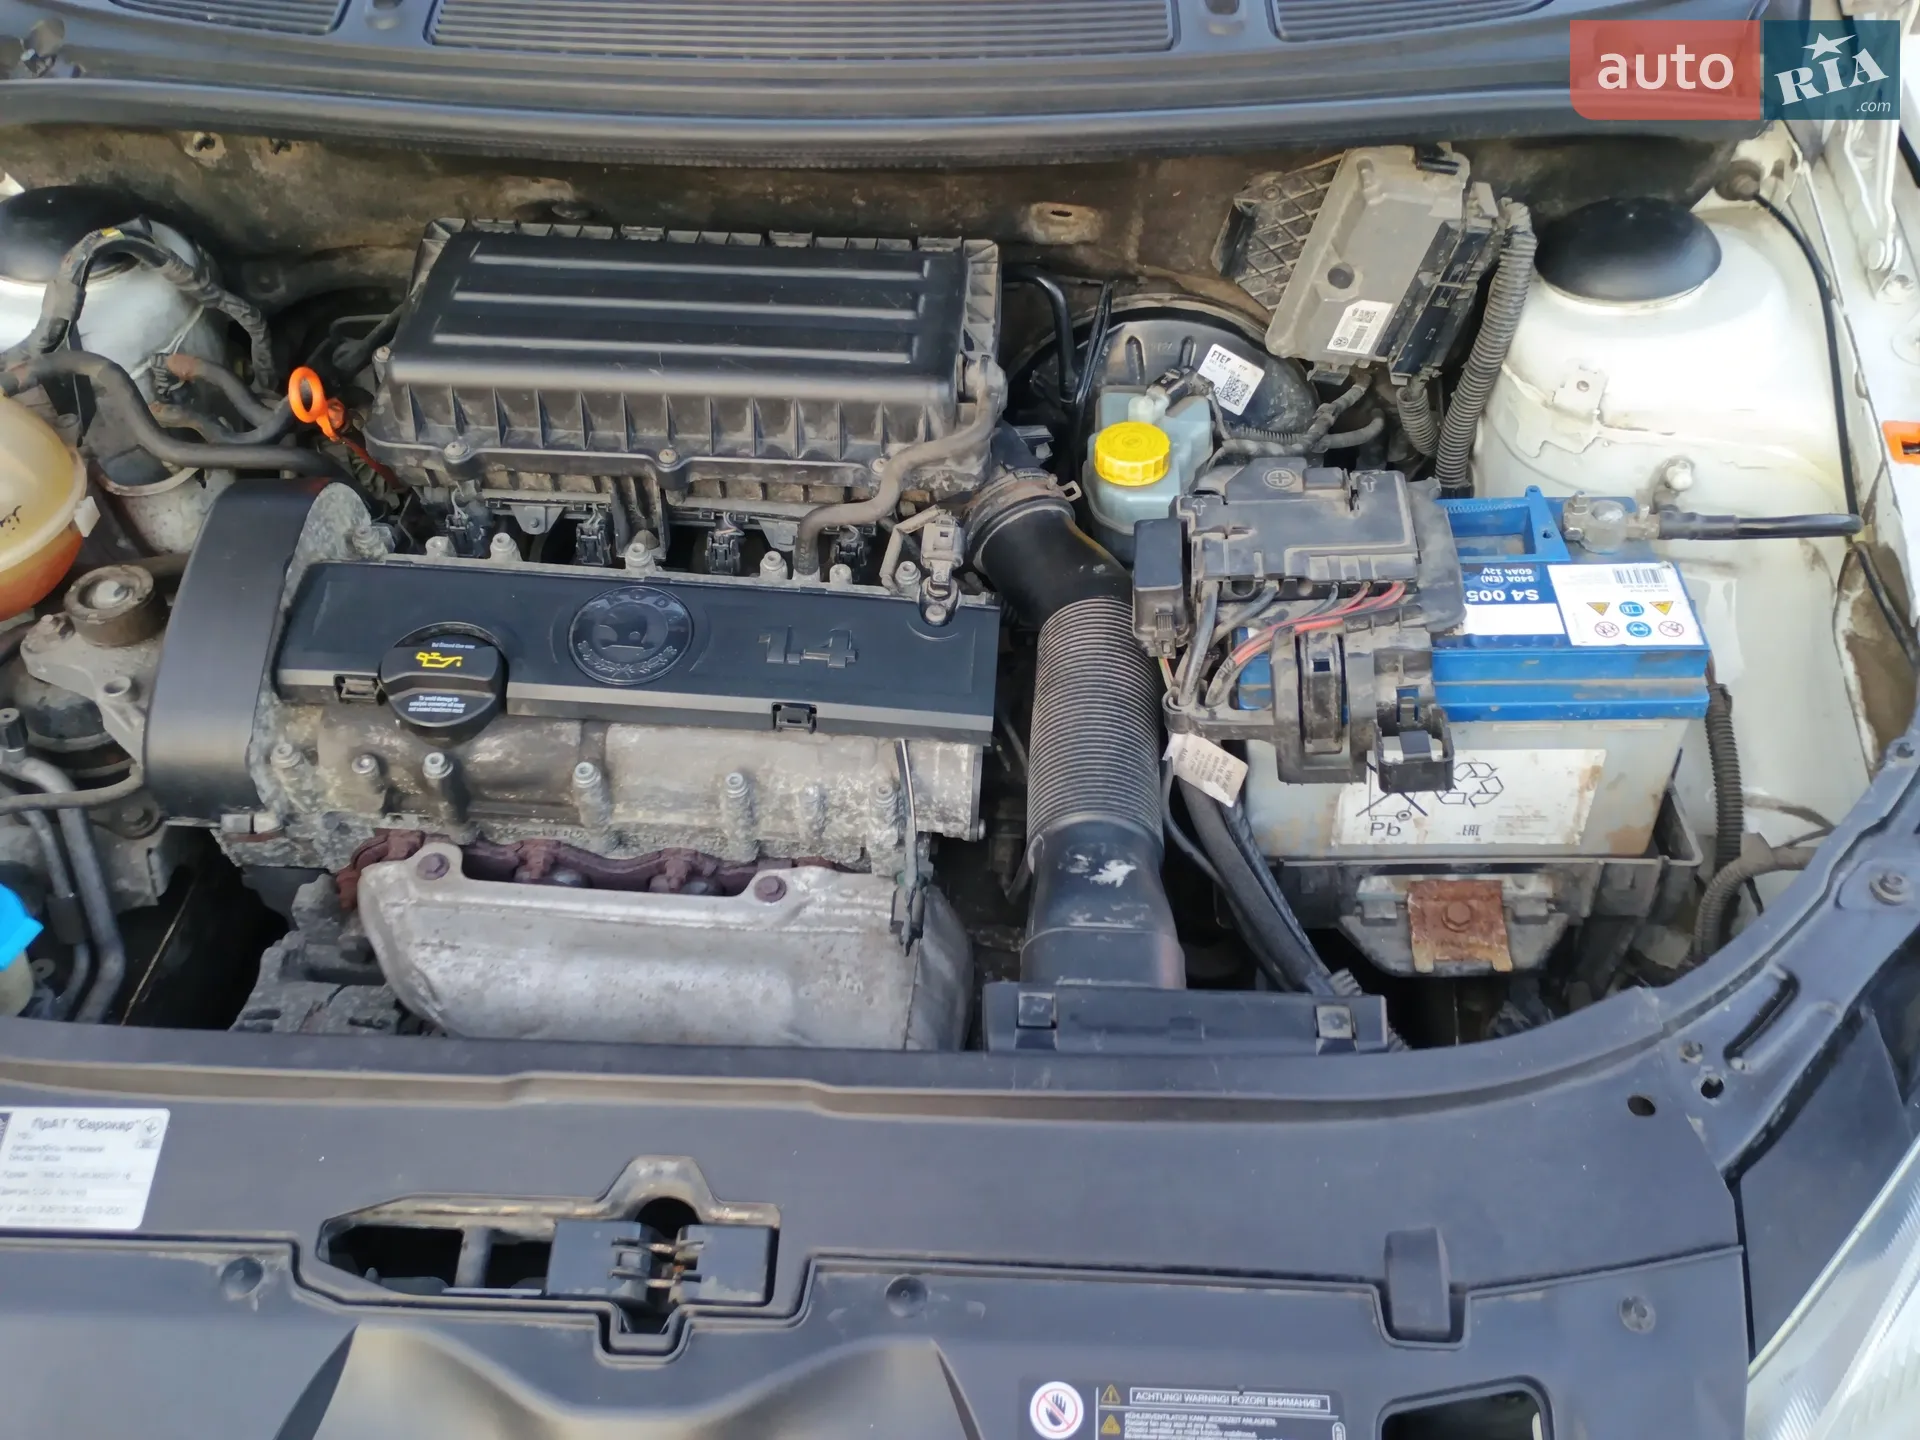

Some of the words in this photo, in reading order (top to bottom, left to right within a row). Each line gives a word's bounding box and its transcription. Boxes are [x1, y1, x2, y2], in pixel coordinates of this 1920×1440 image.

[1482, 567, 1504, 576] 12V
[1505, 567, 1532, 575] 60Ah
[1480, 575, 1504, 584] (EN)
[1506, 575, 1535, 583] 540A
[1466, 589, 1509, 602] 005
[1511, 590, 1540, 602] S4
[758, 625, 859, 668] 1.4
[1369, 822, 1402, 837] Pb
[1135, 1391, 1183, 1402] ACHTUNG!
[1184, 1393, 1230, 1404] WARNING!
[1231, 1395, 1266, 1406] POZOR!
